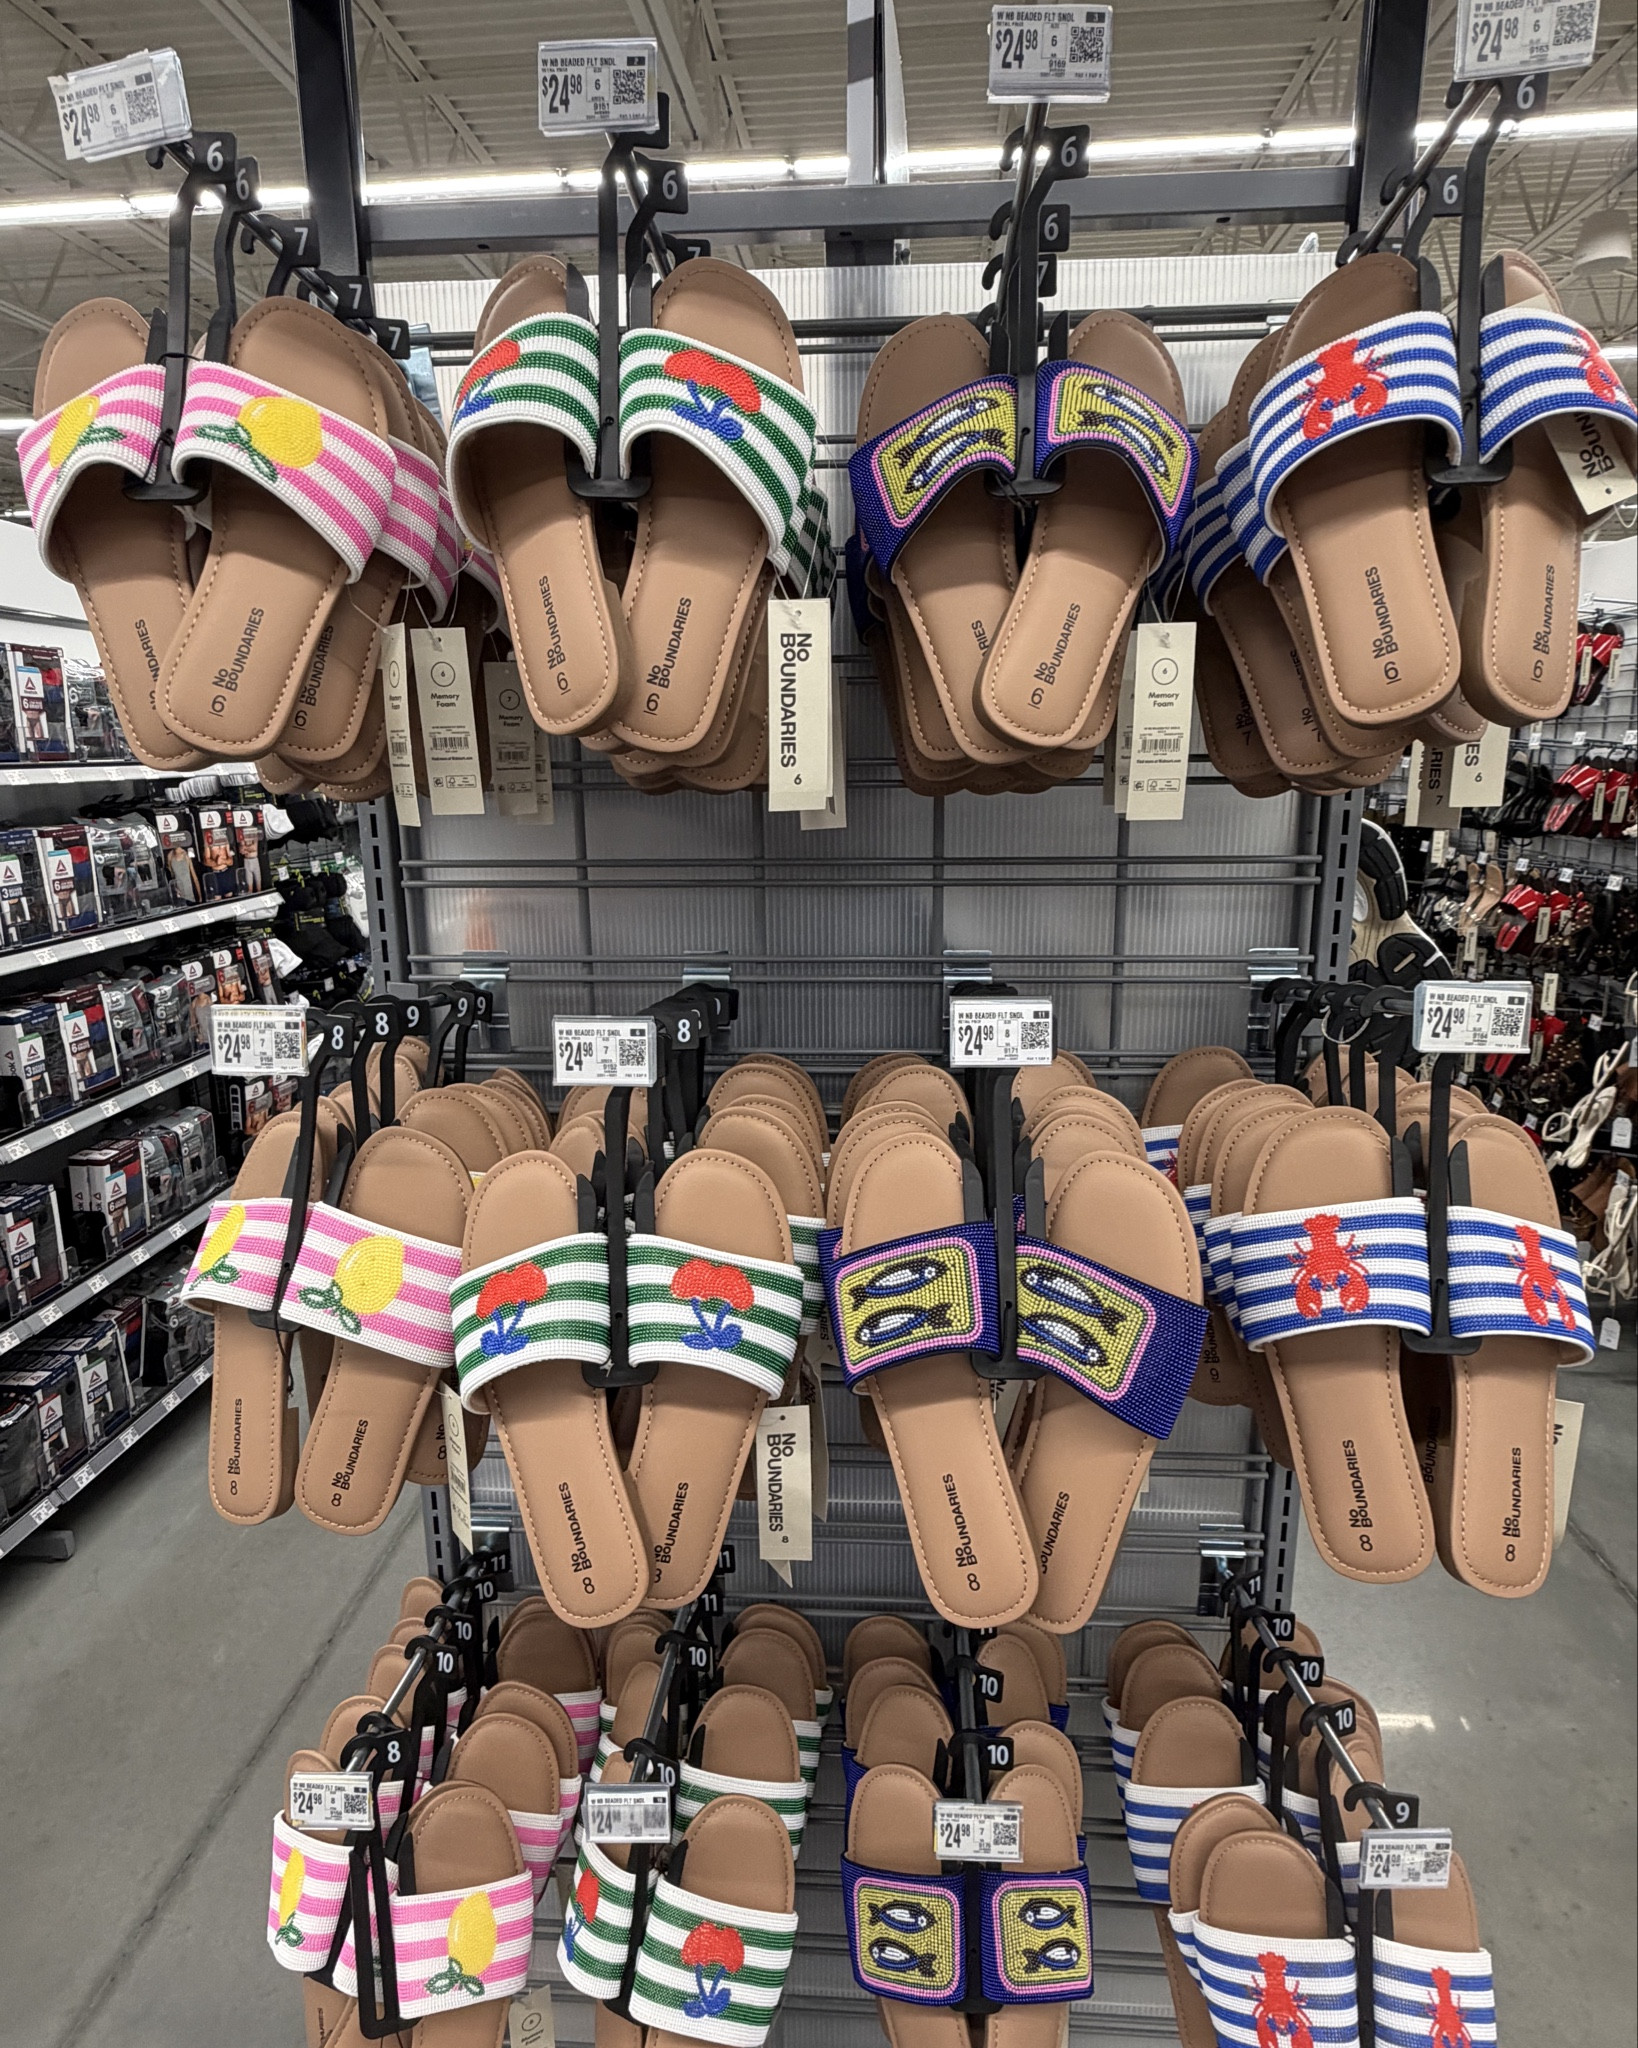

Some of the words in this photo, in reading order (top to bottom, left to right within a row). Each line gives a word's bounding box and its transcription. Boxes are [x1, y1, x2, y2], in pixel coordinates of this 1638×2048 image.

[1496, 0, 1524, 10] BEADED
[996, 12, 1004, 20] W
[1006, 12, 1014, 20] NB
[1020, 12, 1042, 21] BEADED
[1044, 12, 1056, 22] FLT
[1533, 20, 1540, 32] 6
[1051, 36, 1058, 46] 6
[542, 58, 548, 66] W
[550, 58, 558, 66] NB
[560, 58, 585, 66] BEADED
[587, 58, 598, 66] FLT
[600, 58, 616, 66] SNDL
[594, 80, 600, 90] 6
[1517, 75, 1535, 109] 6
[110, 104, 116, 116] 6
[207, 141, 222, 172] 6
[1061, 136, 1078, 167] 6
[236, 168, 249, 200] 6
[662, 170, 678, 200] 6
[1443, 175, 1458, 204] 6
[1044, 213, 1059, 241] 6
[294, 227, 308, 255] 7
[349, 284, 362, 309] 7
[388, 327, 402, 350] 7
[539, 576, 566, 665] BOUNDARIES
[1365, 566, 1398, 654] BOUNDARIES
[1542, 564, 1556, 655] BOUNDARIES
[134, 618, 160, 682] NDARIES
[224, 607, 264, 692] BOUNDARIES
[658, 597, 692, 688] BOUNDARIES
[797, 633, 812, 662] NO
[1044, 602, 1080, 685] BOUNDARIES
[306, 624, 334, 706] BOUNDARIES
[1384, 661, 1402, 685] 6
[1530, 659, 1544, 682] 6
[556, 671, 570, 695] 6
[208, 694, 227, 717] 6
[644, 692, 660, 716] 6
[780, 633, 796, 768] BOUNDARIES
[1028, 688, 1044, 710] 6
[1148, 692, 1180, 700] Memory
[1153, 700, 1174, 708] Foam
[498, 714, 524, 722] Memory
[794, 774, 802, 785] 6
[1474, 772, 1482, 782] 6
[1436, 794, 1444, 806] 7
[457, 998, 468, 1018] 9
[477, 996, 486, 1014] 9
[1446, 994, 1469, 1002] BEADED
[1471, 995, 1482, 1003] FLT
[376, 1012, 390, 1036] 8
[406, 1006, 420, 1028] 9
[958, 1012, 964, 1020] W
[966, 1012, 973, 1020] NB
[975, 1012, 996, 1020] BEADED
[1010, 1012, 1024, 1020] SNDL
[1476, 1014, 1482, 1022] 7
[332, 1025, 344, 1050] 8
[678, 1019, 690, 1042] 8
[1005, 1030, 1010, 1038] 8
[260, 1039, 265, 1048] 7
[604, 1046, 608, 1054] 7
[234, 1398, 242, 1475] BOUNDARIES
[782, 1433, 796, 1458] NO
[340, 1419, 368, 1490] BOUNDARIES
[230, 1480, 238, 1496] 8
[767, 1434, 784, 1532] BOUNDARIES
[1342, 1439, 1374, 1528] BOUNDARIES
[1512, 1448, 1522, 1538] BOUNDARIES
[331, 1492, 342, 1507] 8
[558, 1482, 592, 1570] BOUNDARIES
[661, 1482, 689, 1564] BOUNDARIES
[942, 1474, 978, 1566] BOUNDARIES
[782, 1536, 789, 1544] 8
[1360, 1534, 1374, 1552] 8
[491, 1555, 506, 1572] 11
[1505, 1544, 1516, 1562] 8
[476, 1581, 494, 1600] 10
[582, 1576, 596, 1594] 8
[966, 1572, 980, 1592] 8
[1250, 1576, 1261, 1594] 11
[702, 1594, 718, 1612] 11
[455, 1621, 472, 1640] 10
[1273, 1618, 1292, 1637] 10
[436, 1652, 454, 1674] 10
[689, 1647, 707, 1667] 10
[1300, 1661, 1320, 1682] 10
[979, 1674, 998, 1696] 10
[1335, 1707, 1353, 1728] 10
[387, 1740, 400, 1763] 8
[988, 1745, 1009, 1766] 10
[658, 1763, 676, 1787] 10
[1396, 1802, 1410, 1823] 9
